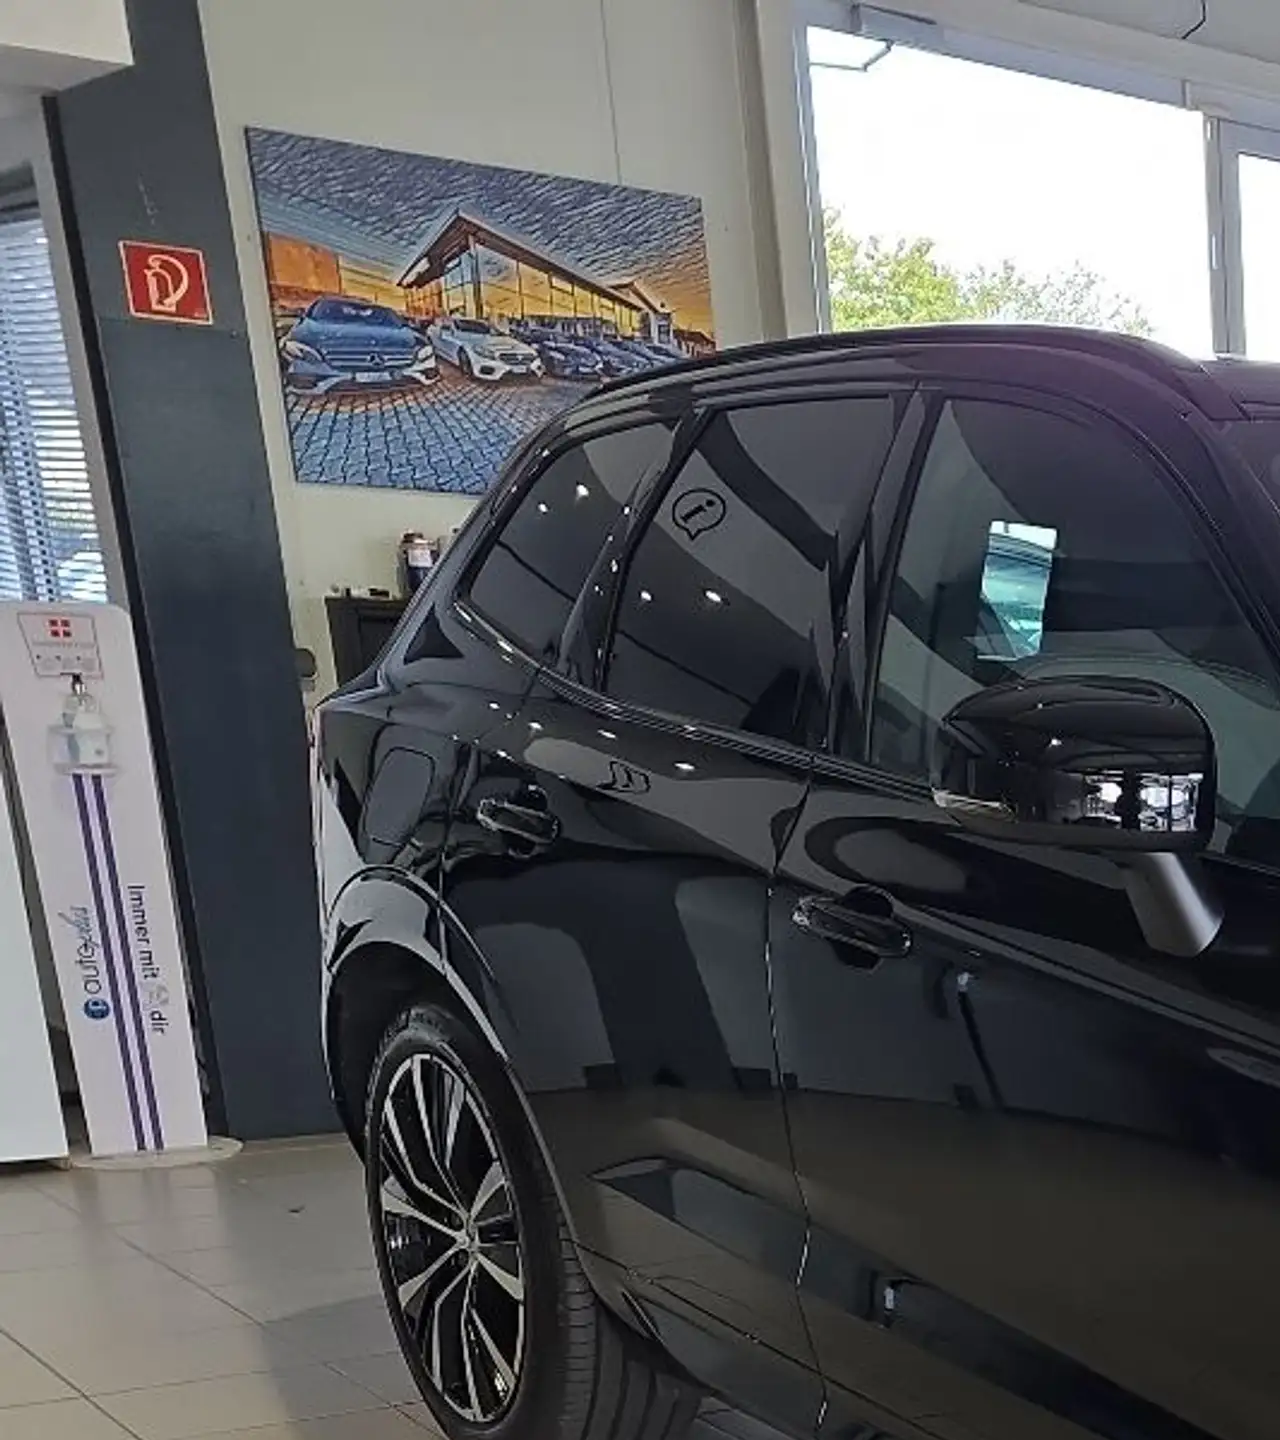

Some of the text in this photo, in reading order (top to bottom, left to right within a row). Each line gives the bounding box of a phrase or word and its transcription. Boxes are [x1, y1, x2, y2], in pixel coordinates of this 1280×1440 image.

[128, 884, 169, 1037] Immer mit dir
